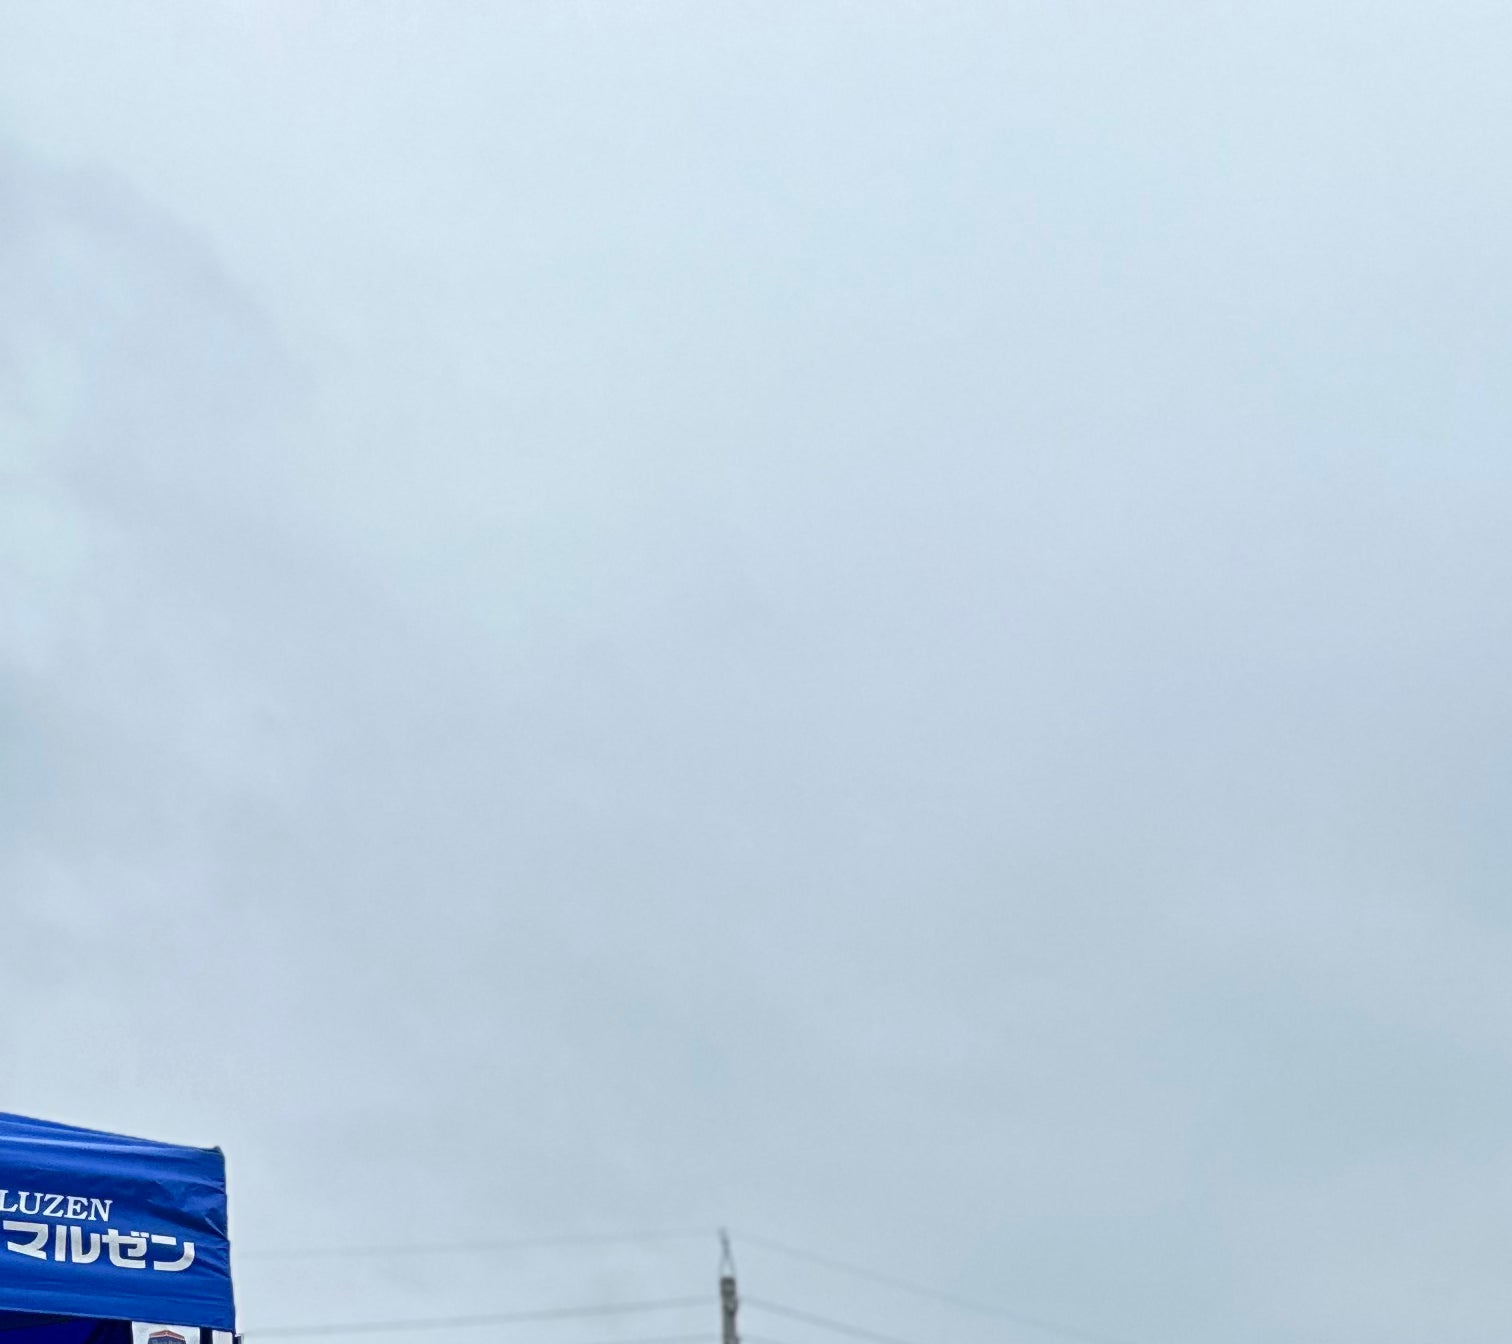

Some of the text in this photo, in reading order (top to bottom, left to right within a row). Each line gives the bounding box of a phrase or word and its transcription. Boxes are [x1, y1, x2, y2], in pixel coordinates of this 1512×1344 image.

[0, 1189, 113, 1222] LUZEN
[3, 1220, 196, 1272] マルゼン
